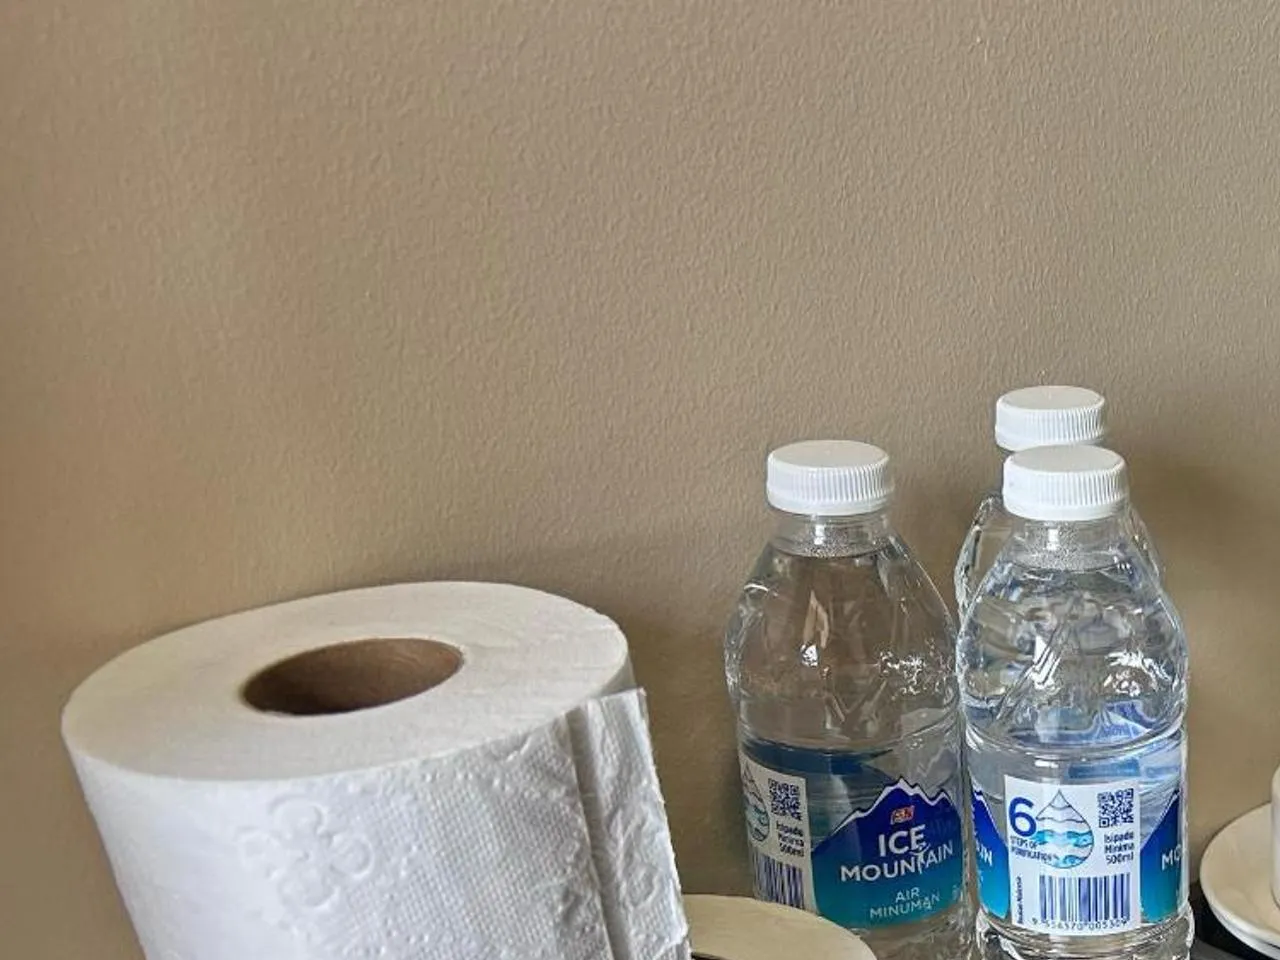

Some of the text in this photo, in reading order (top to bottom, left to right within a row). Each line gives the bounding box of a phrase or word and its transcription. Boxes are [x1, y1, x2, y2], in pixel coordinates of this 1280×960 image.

[1009, 796, 1037, 837] 6
[878, 824, 926, 857] ICE
[840, 840, 954, 882] MOUNTAIN
[869, 893, 940, 919] MINUMAN
[895, 887, 920, 903] AIR
